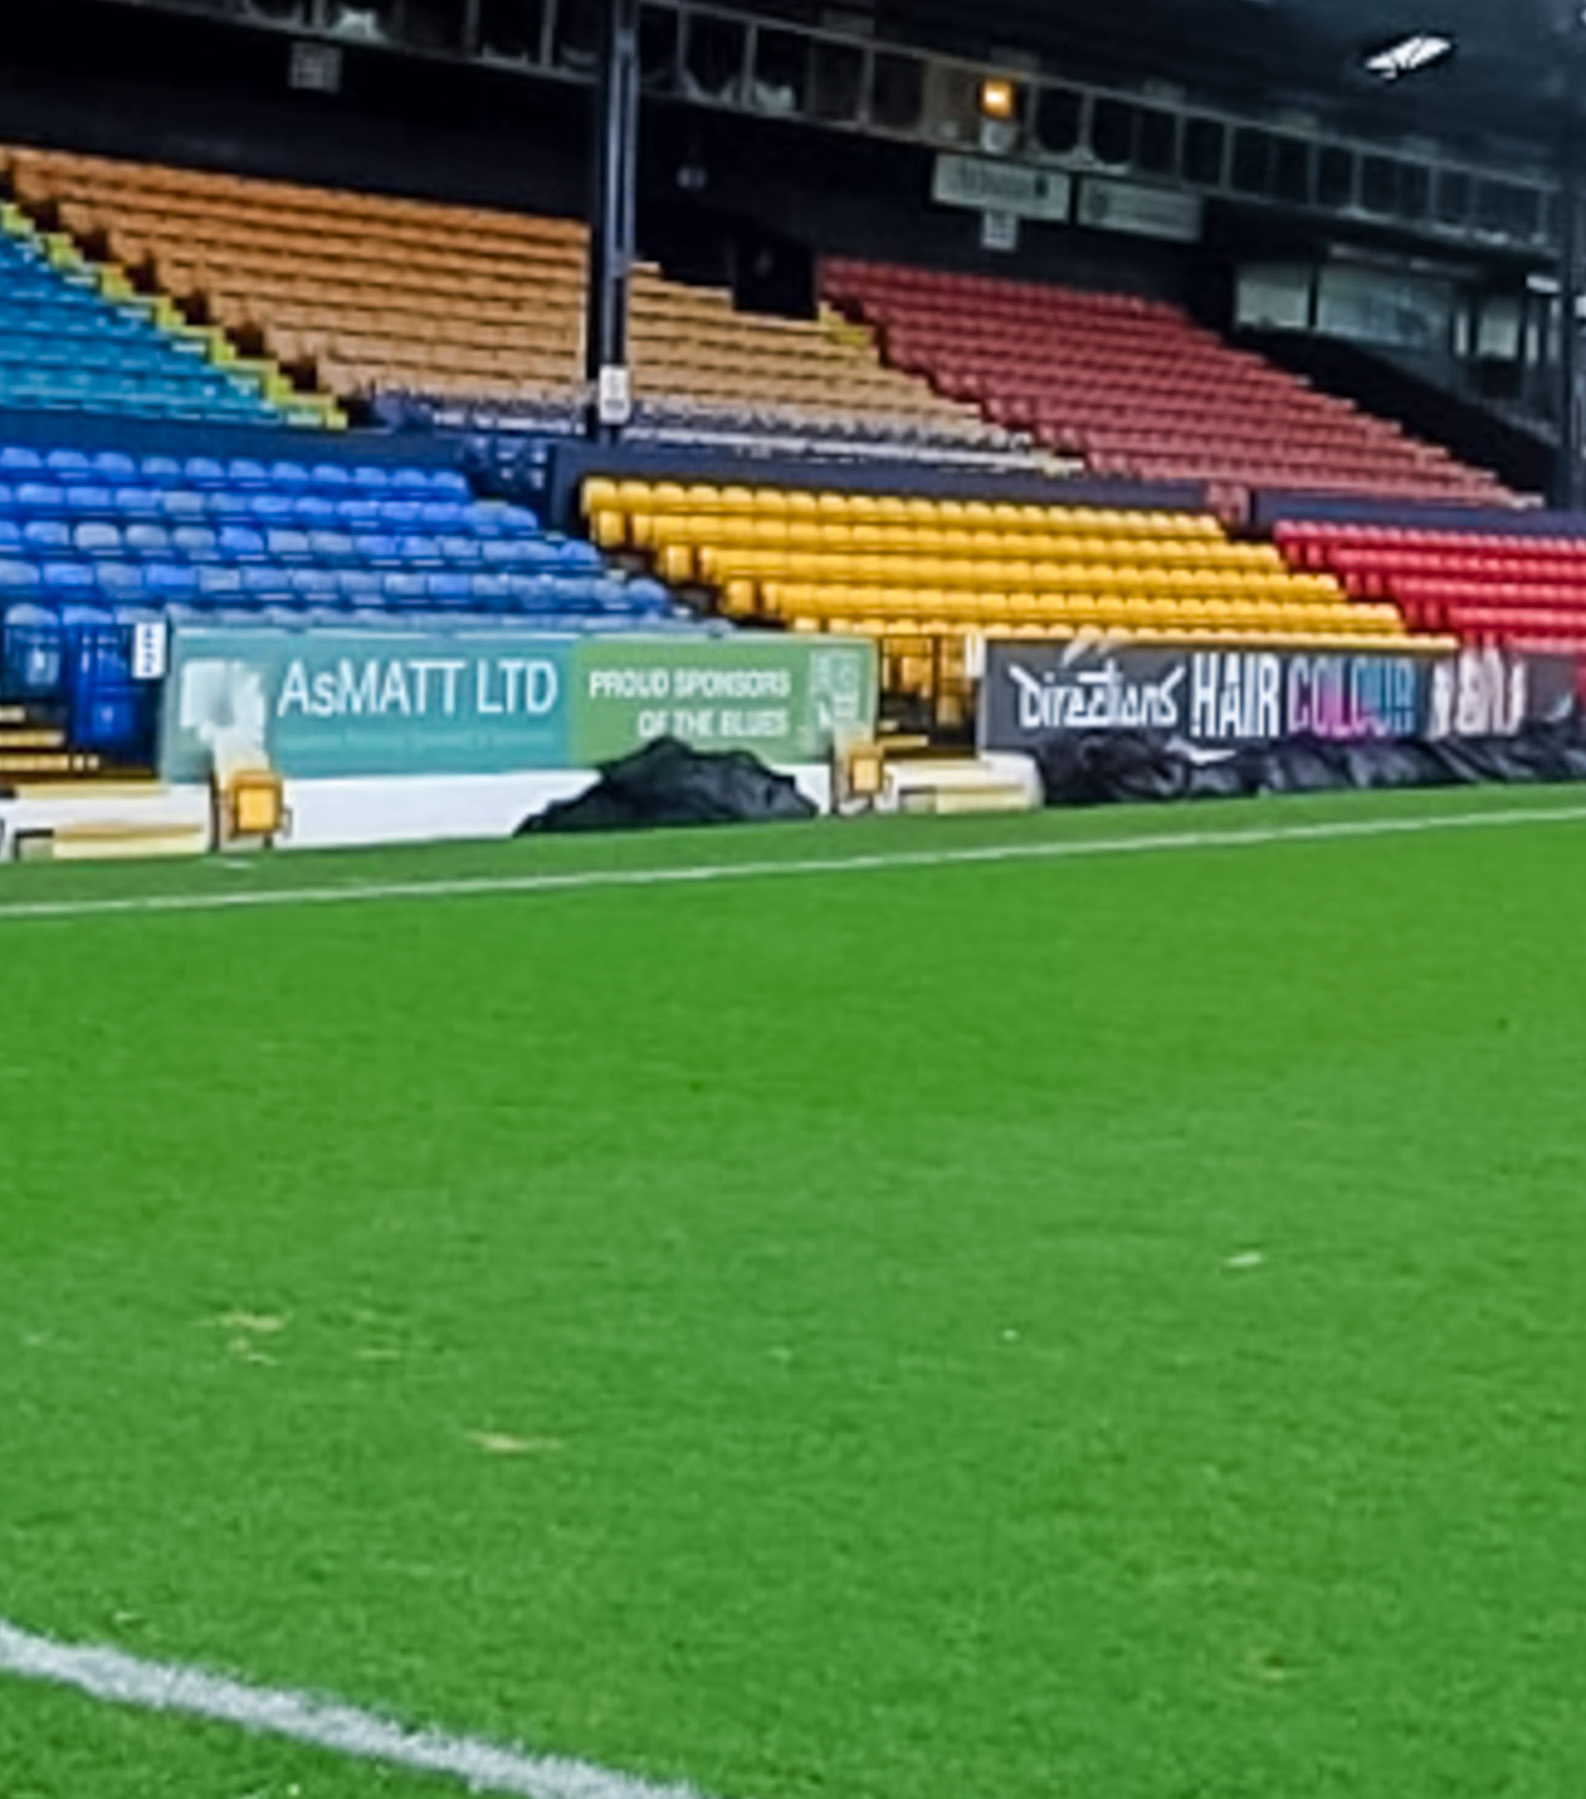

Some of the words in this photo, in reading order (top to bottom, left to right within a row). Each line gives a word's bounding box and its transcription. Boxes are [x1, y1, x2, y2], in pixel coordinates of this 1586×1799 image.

[277, 659, 466, 717] AsMATT
[477, 659, 558, 714] LTD
[590, 671, 669, 698] PROUD
[674, 670, 791, 697] SPONSORS
[1190, 652, 1279, 737] HAIR
[1288, 655, 1414, 738] COLOUR
[638, 711, 666, 737] OF
[670, 710, 714, 736] THE
[721, 709, 787, 737] BLUES
